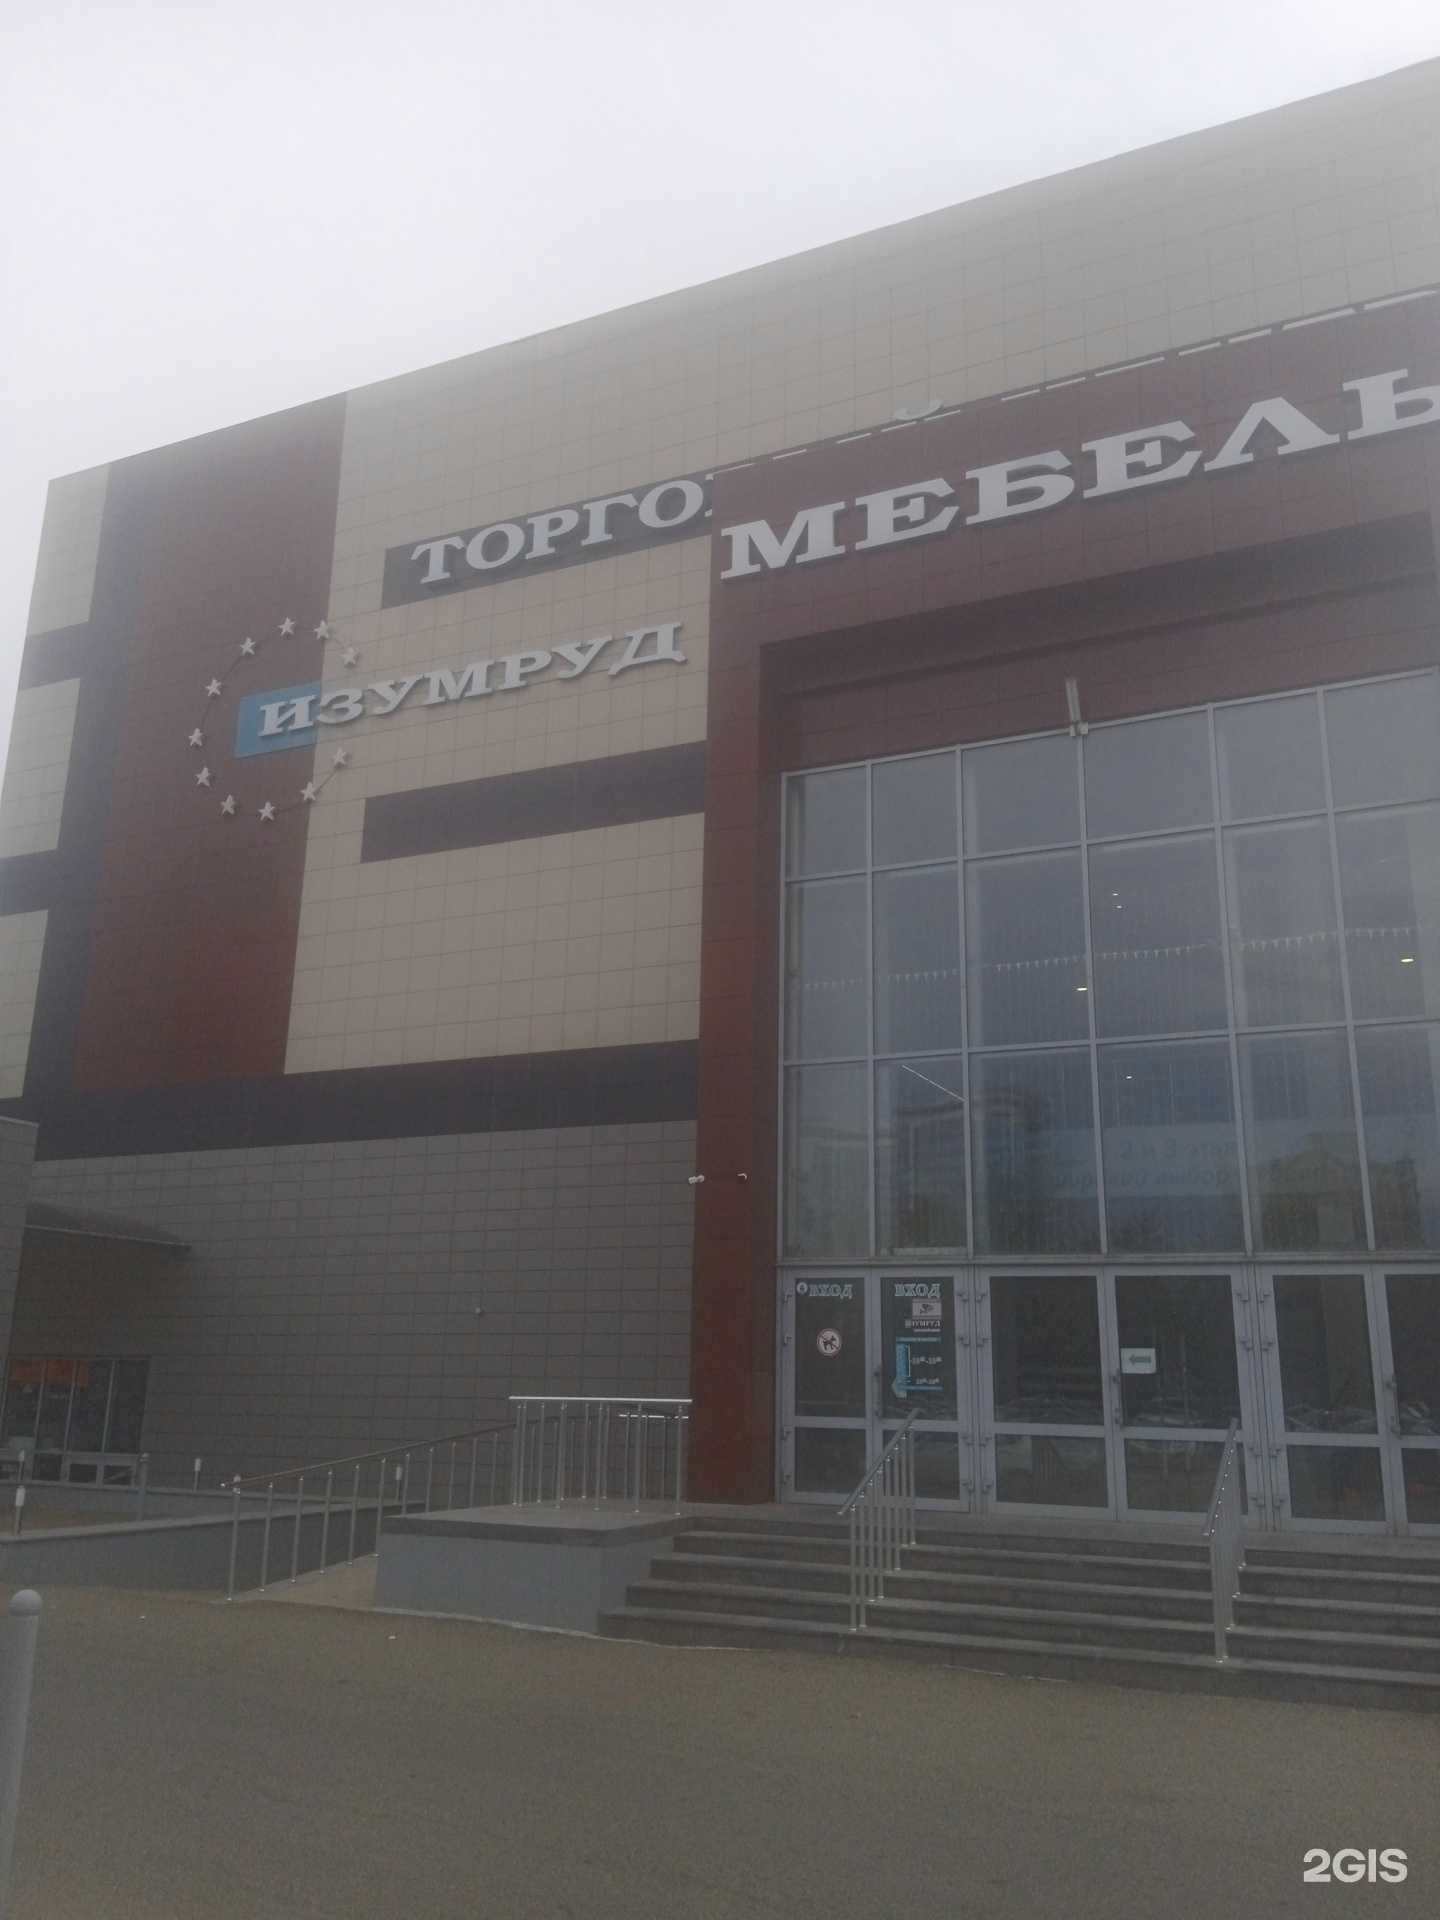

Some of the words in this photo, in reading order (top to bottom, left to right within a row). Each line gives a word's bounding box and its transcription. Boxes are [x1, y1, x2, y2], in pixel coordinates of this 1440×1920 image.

[411, 473, 713, 584] ТОРГО
[720, 368, 1440, 579] МЕБЕЛЬ
[258, 621, 688, 737] ИЗУМРУД
[809, 1284, 853, 1299] ВХОД
[894, 1283, 941, 1298] ВХОД
